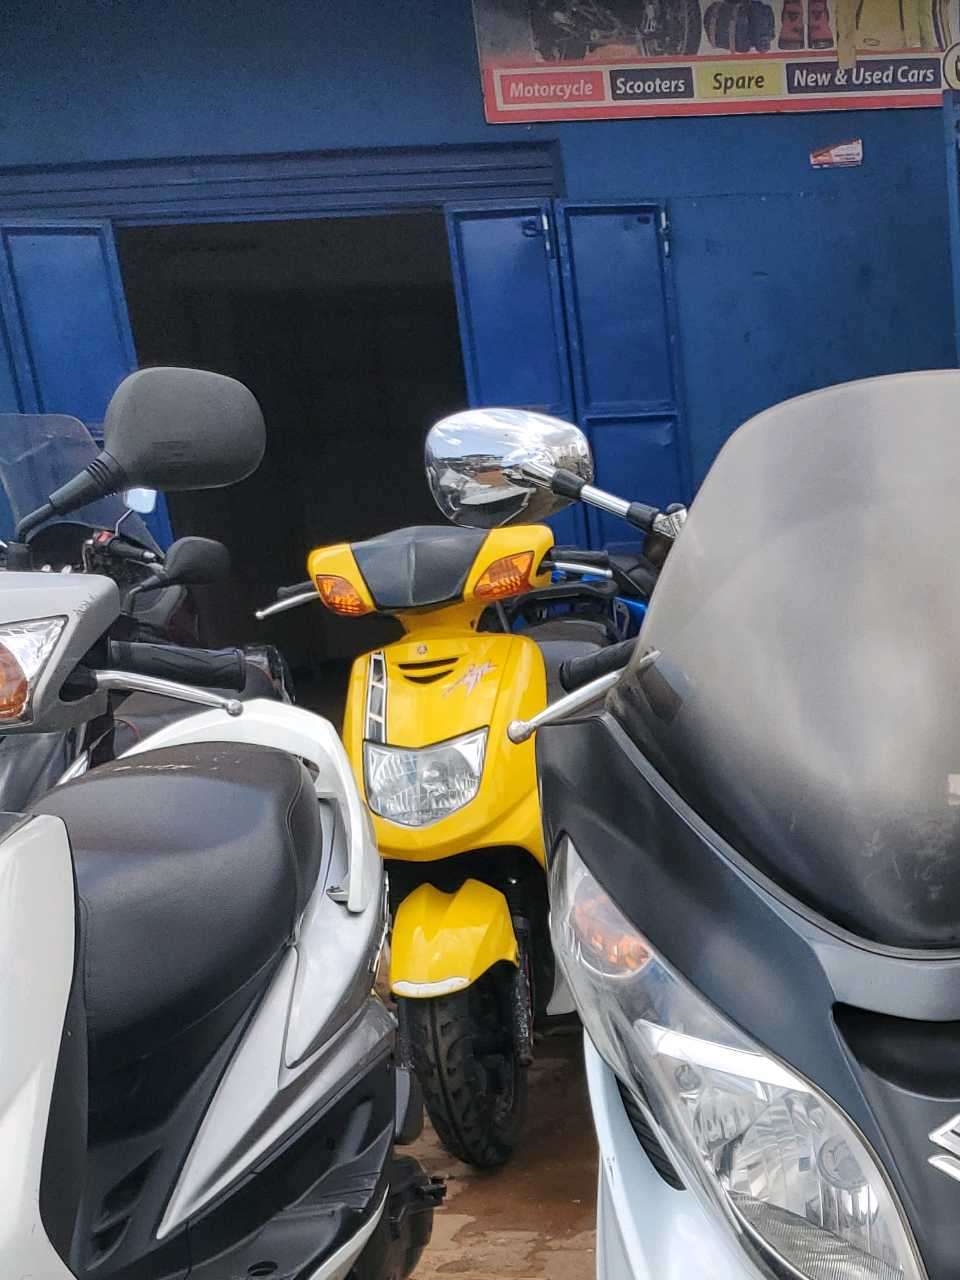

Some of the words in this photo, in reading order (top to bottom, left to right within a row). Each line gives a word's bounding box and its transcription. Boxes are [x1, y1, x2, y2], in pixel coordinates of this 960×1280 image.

[713, 73, 765, 93] Spare
[794, 69, 831, 86] New
[835, 67, 848, 85] &
[851, 65, 893, 84] Used
[897, 65, 935, 83] Cars
[510, 80, 593, 99] Motorcycle
[616, 77, 686, 94] Scooters
